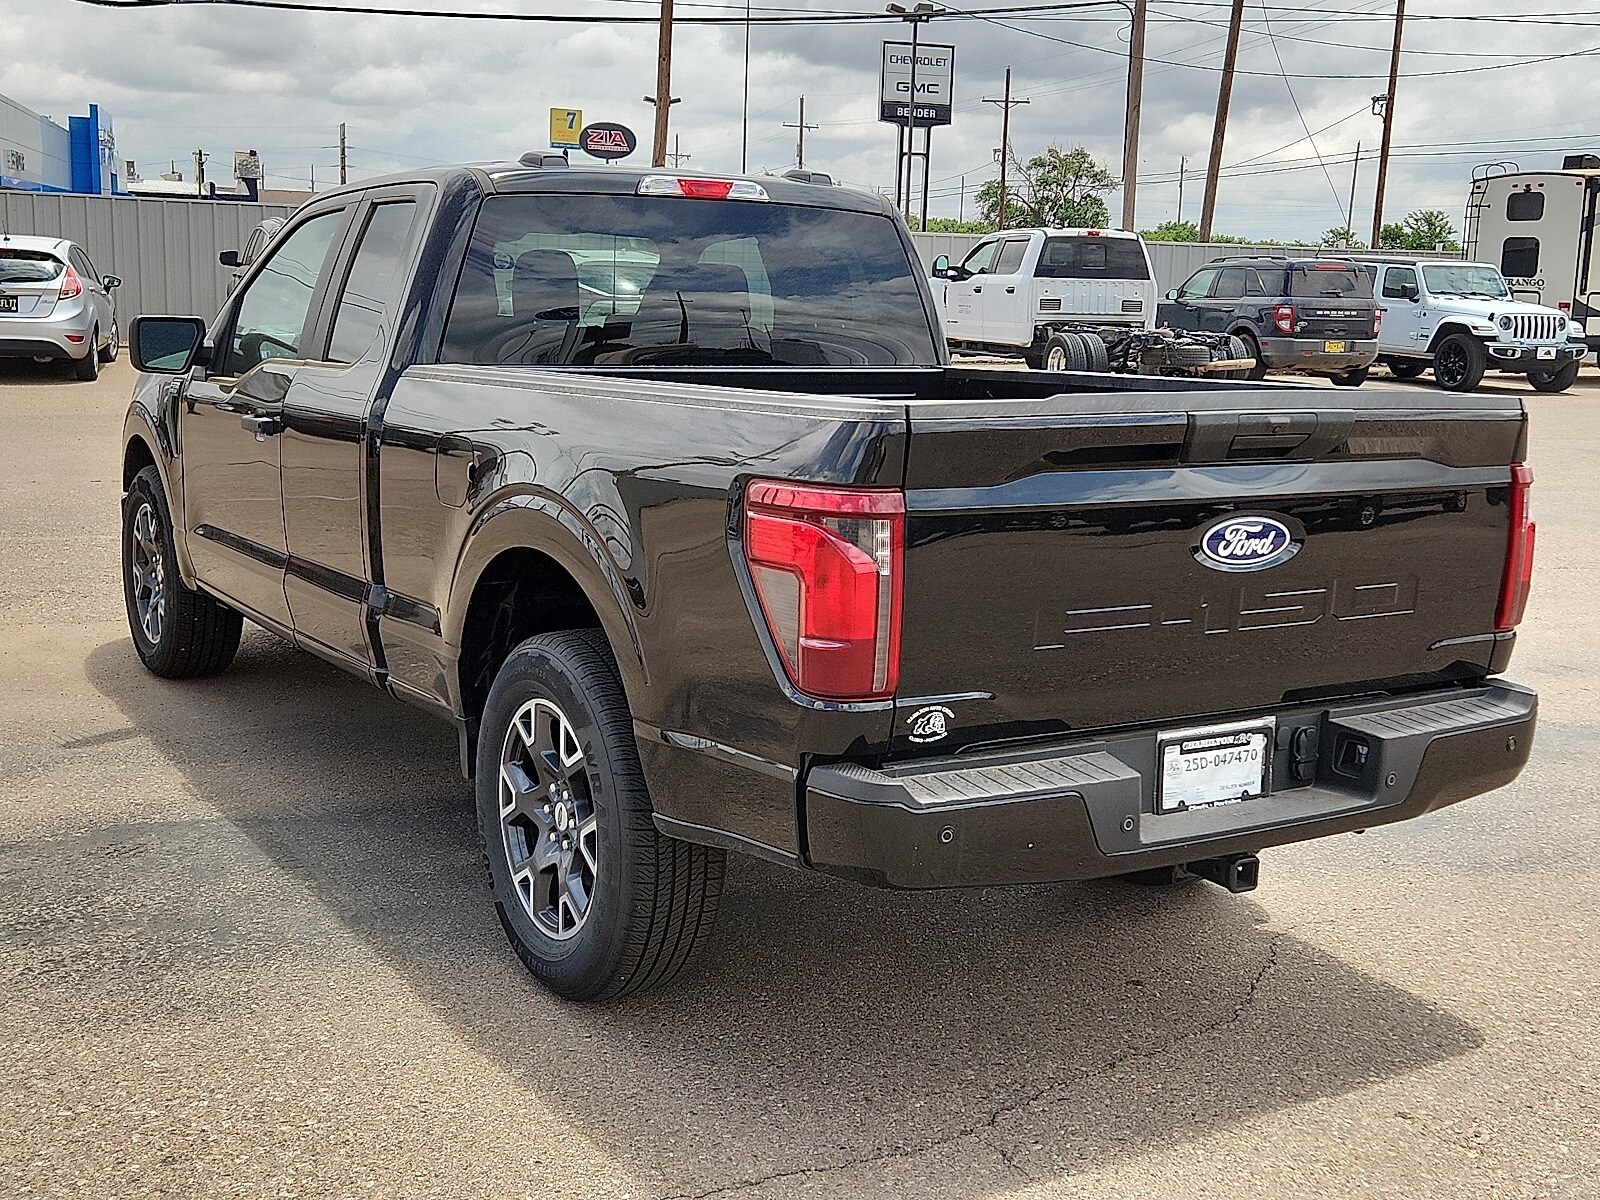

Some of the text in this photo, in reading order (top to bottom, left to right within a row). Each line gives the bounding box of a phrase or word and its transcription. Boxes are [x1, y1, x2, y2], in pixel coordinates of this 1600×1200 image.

[896, 81, 940, 94] GMC
[566, 111, 577, 130] 7
[897, 107, 937, 119] BENDER
[586, 129, 628, 147] ZIA
[1504, 278, 1545, 287] RANGO
[1217, 523, 1275, 558] Ford
[1033, 574, 1421, 650] F-150
[1184, 749, 1258, 772] 25D-047470
